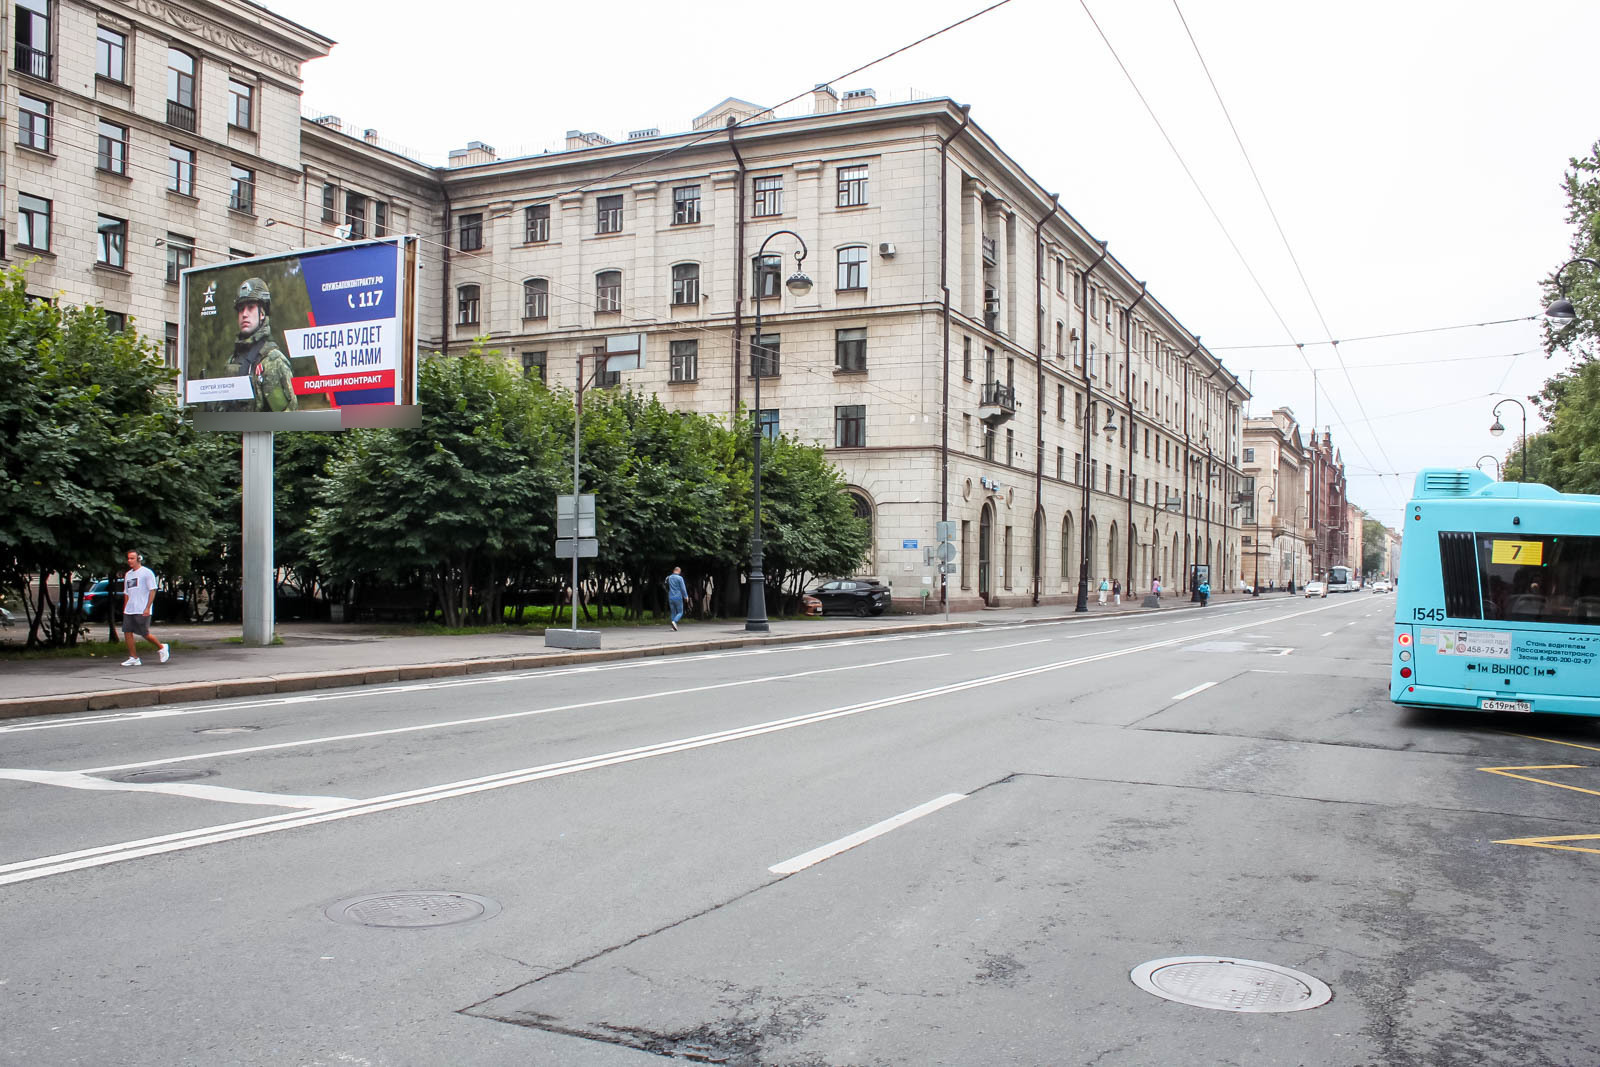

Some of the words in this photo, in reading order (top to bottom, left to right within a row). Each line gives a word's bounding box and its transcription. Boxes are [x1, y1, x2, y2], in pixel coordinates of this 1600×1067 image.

[322, 275, 384, 292] СЛУЖБАПОКОНТРАКТУ.РФ
[359, 290, 383, 307] 117
[303, 330, 344, 350] ПОБЕДА
[347, 326, 382, 346] БУДЕТ
[334, 351, 347, 368] ЗА
[350, 347, 382, 367] НАМИ
[304, 378, 343, 390] ПОДПИШИ
[343, 375, 382, 386] КОНТРАКТ
[1511, 545, 1522, 560] 7
[1413, 607, 1445, 622] 1545
[1467, 645, 1509, 654] 458-75-74
[1477, 663, 1488, 673] 1м
[1491, 664, 1530, 675] ВЫНОС
[1533, 666, 1545, 676] 1м
